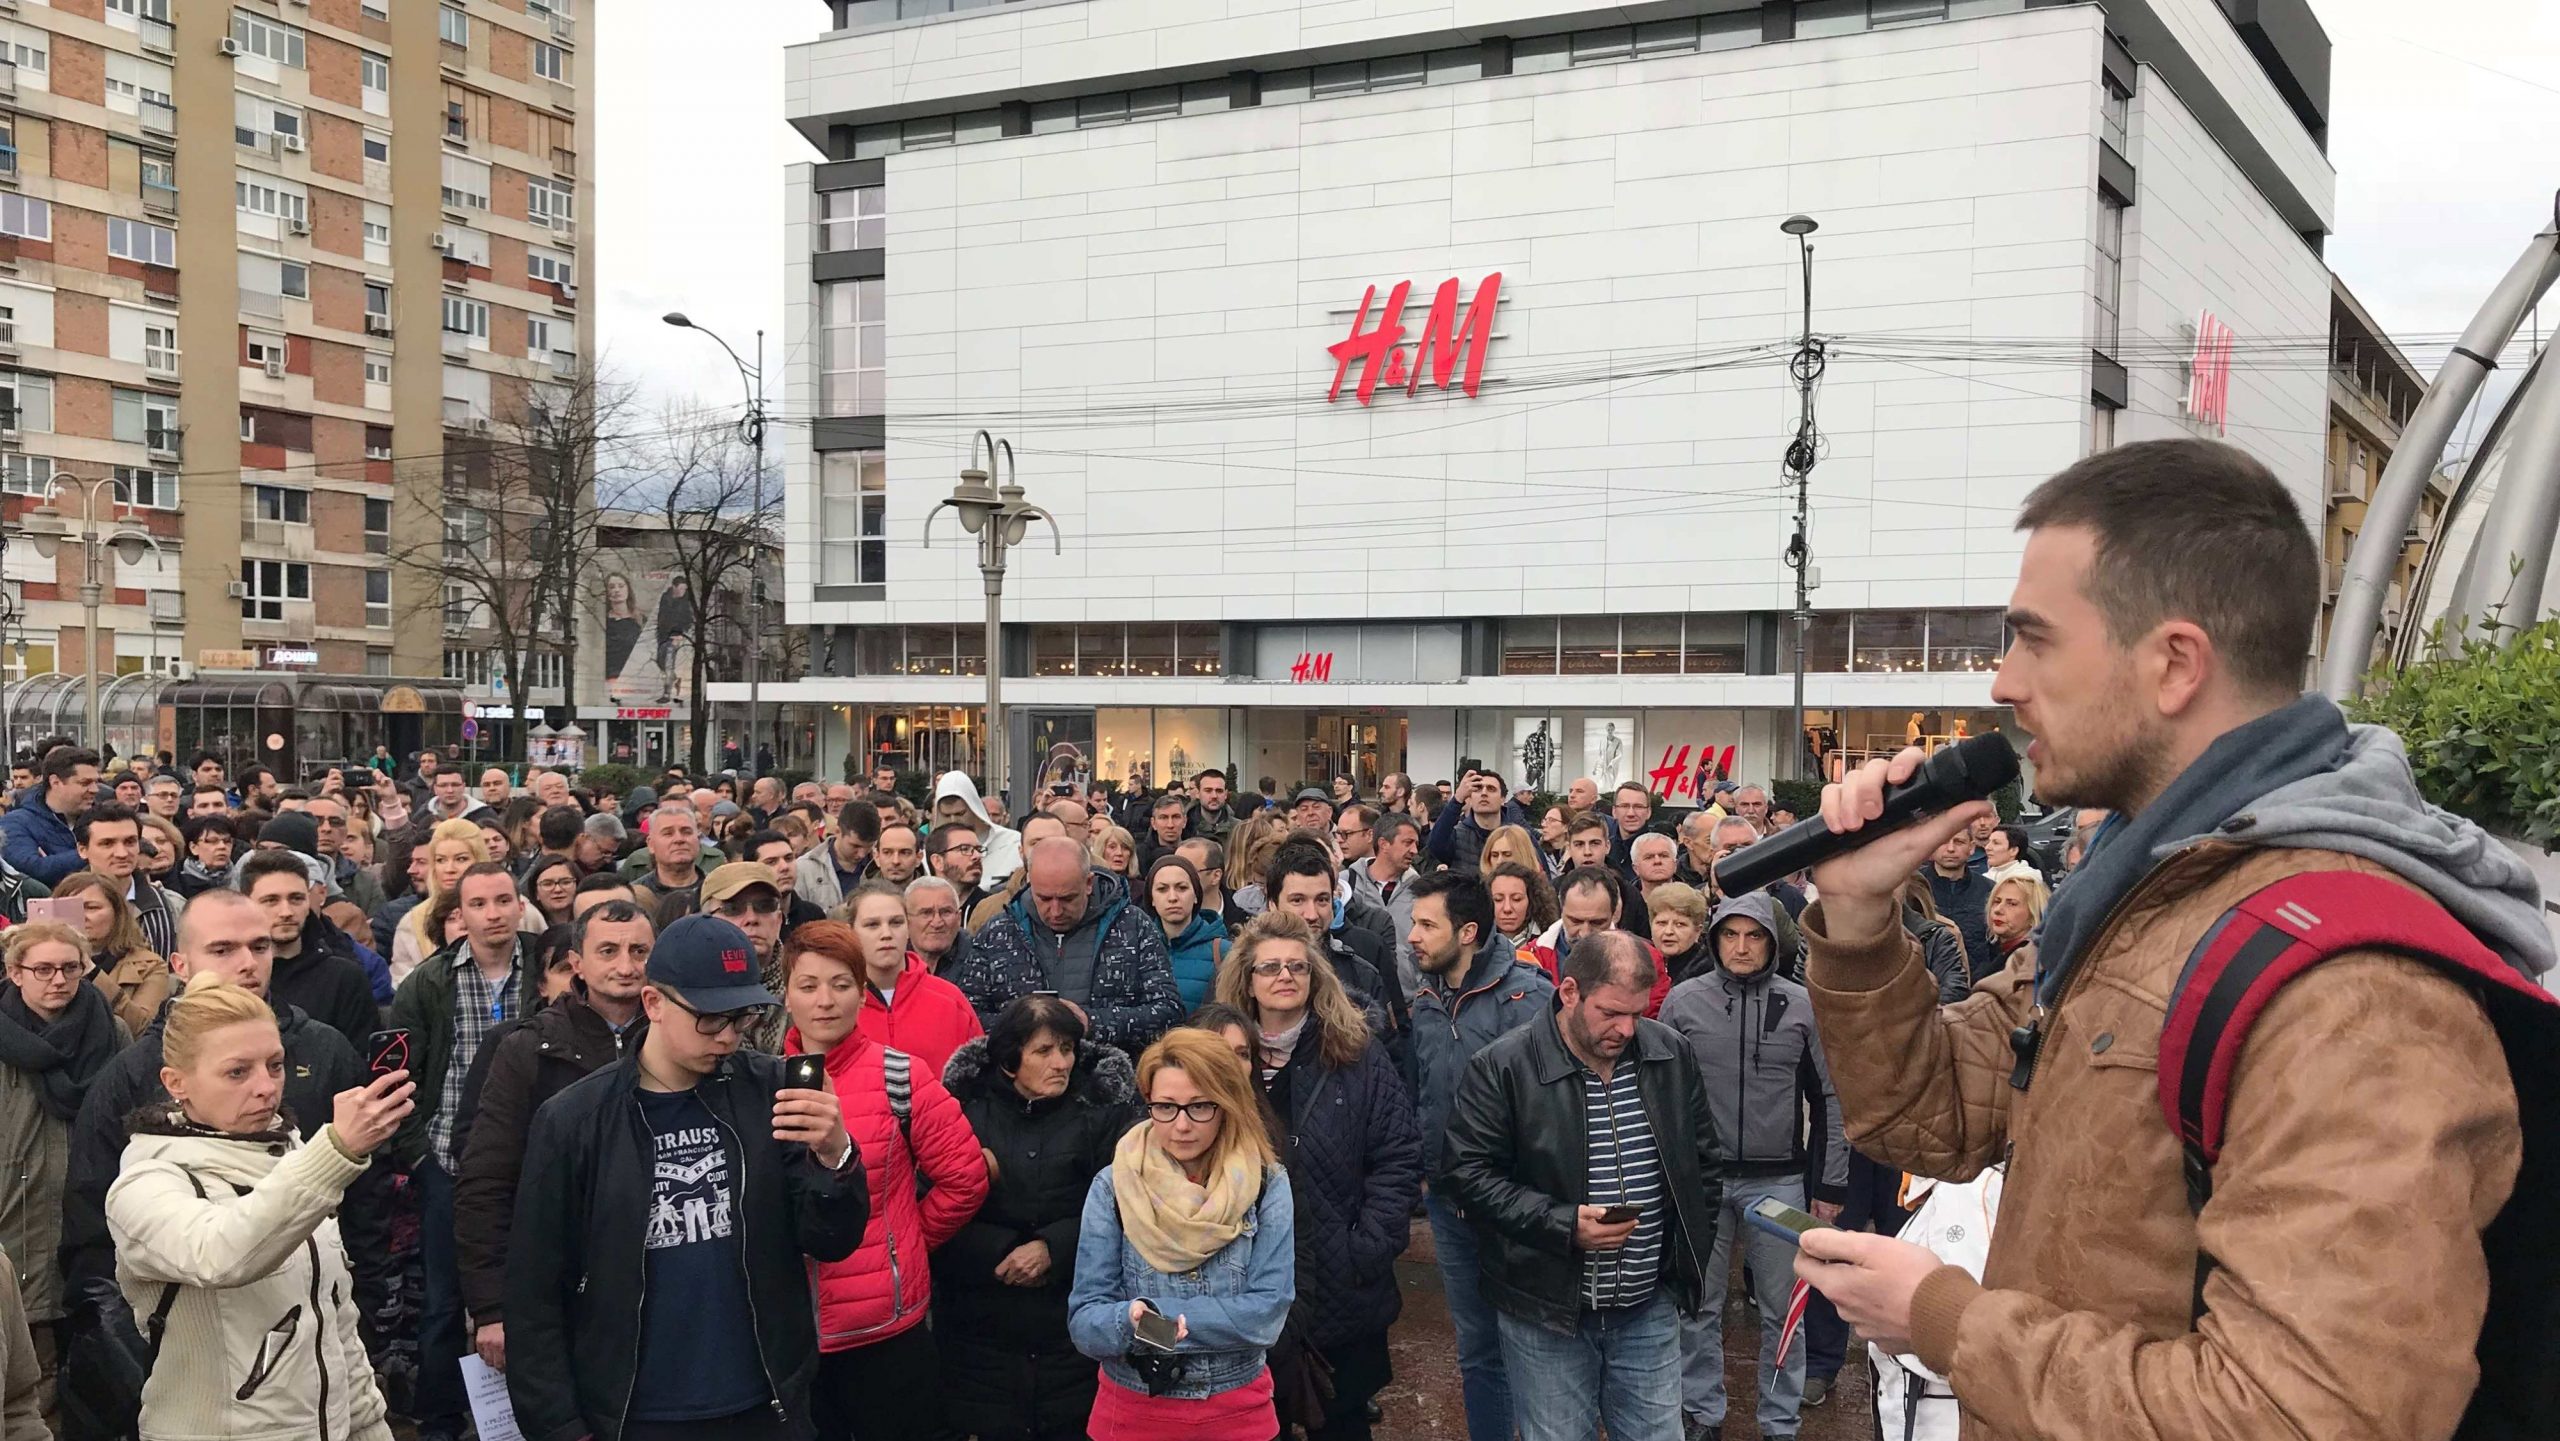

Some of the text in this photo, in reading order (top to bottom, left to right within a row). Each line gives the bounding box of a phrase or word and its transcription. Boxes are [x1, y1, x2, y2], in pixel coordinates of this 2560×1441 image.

[1327, 272, 1502, 406] H&M
[1291, 652, 1333, 684] H&M
[1648, 745, 1735, 800] H&M
[654, 1127, 720, 1151] TRAUSS
